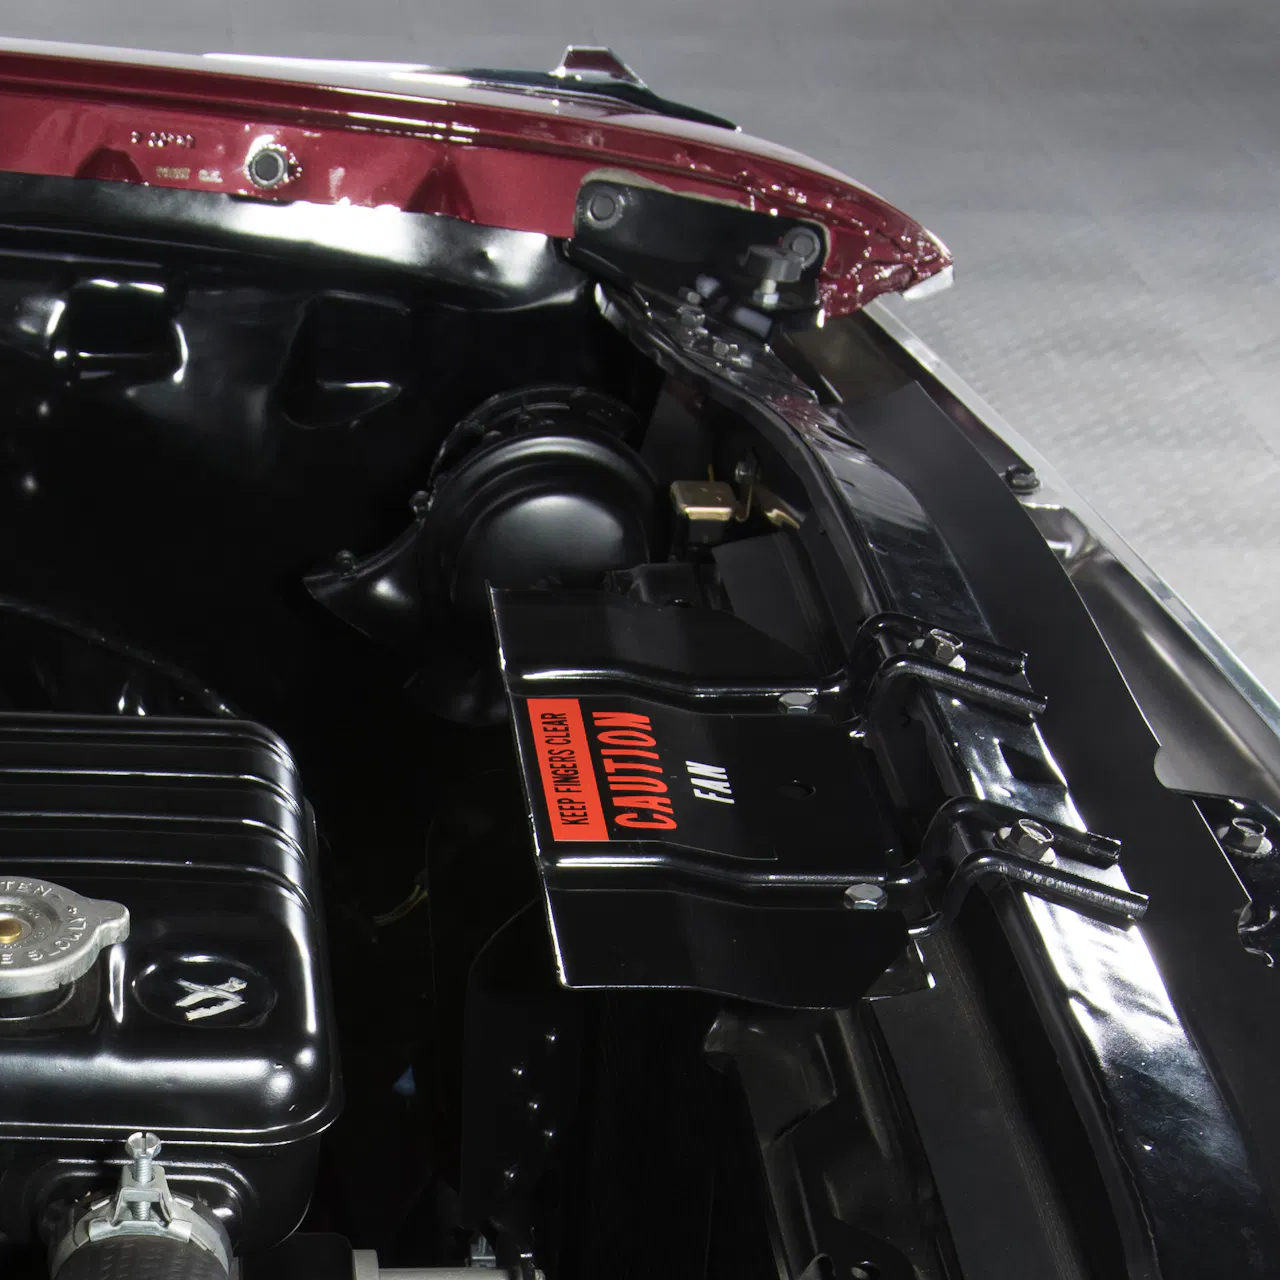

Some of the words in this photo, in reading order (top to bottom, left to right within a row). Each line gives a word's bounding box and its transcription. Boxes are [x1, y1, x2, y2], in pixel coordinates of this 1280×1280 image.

[541, 712, 572, 746] CLEAR
[548, 748, 583, 795] FINGERS
[592, 711, 678, 830] CAUTION
[685, 760, 735, 804] FAN
[554, 798, 590, 825] KEEP
